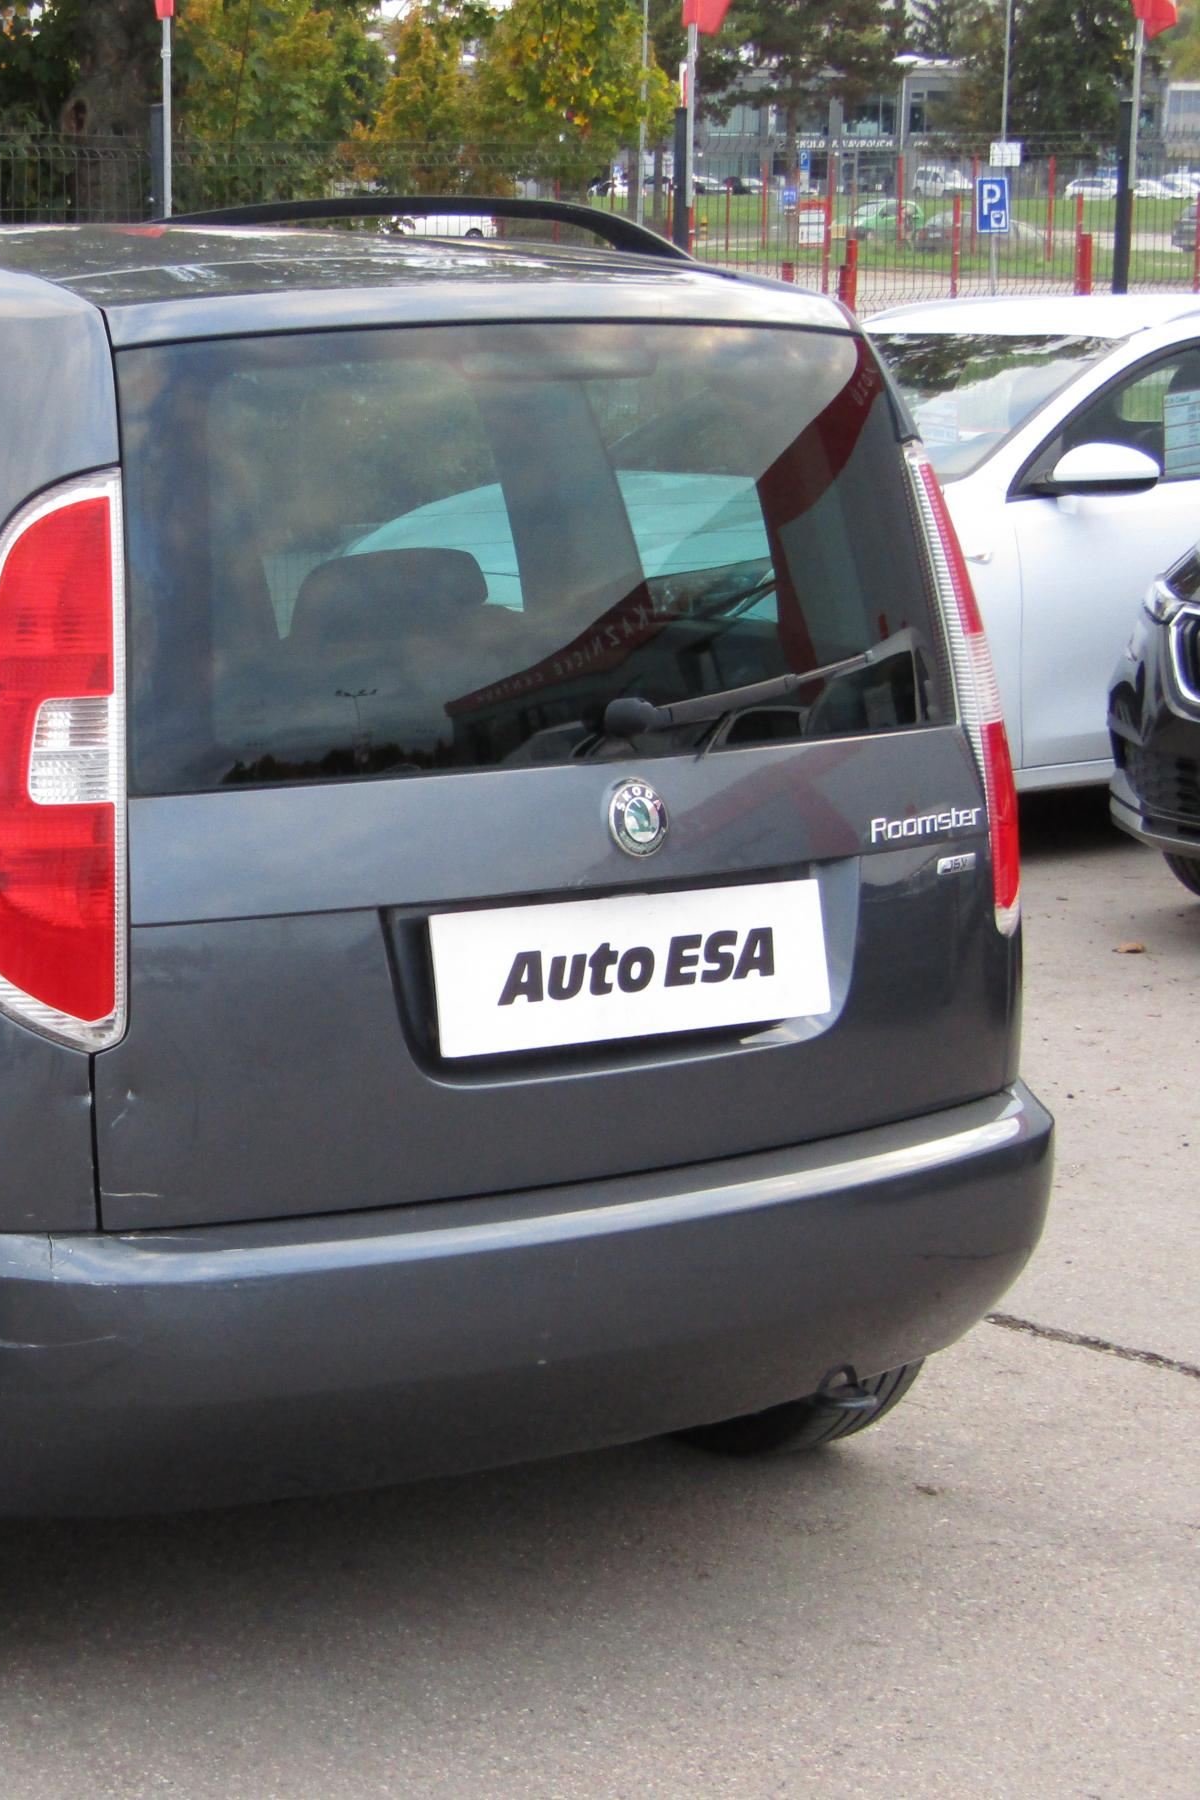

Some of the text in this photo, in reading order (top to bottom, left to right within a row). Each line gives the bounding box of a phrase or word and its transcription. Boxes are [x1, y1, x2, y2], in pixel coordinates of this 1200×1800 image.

[982, 183, 1001, 216] P
[870, 807, 982, 844] Roomster
[497, 926, 775, 1006] Auto ESA
